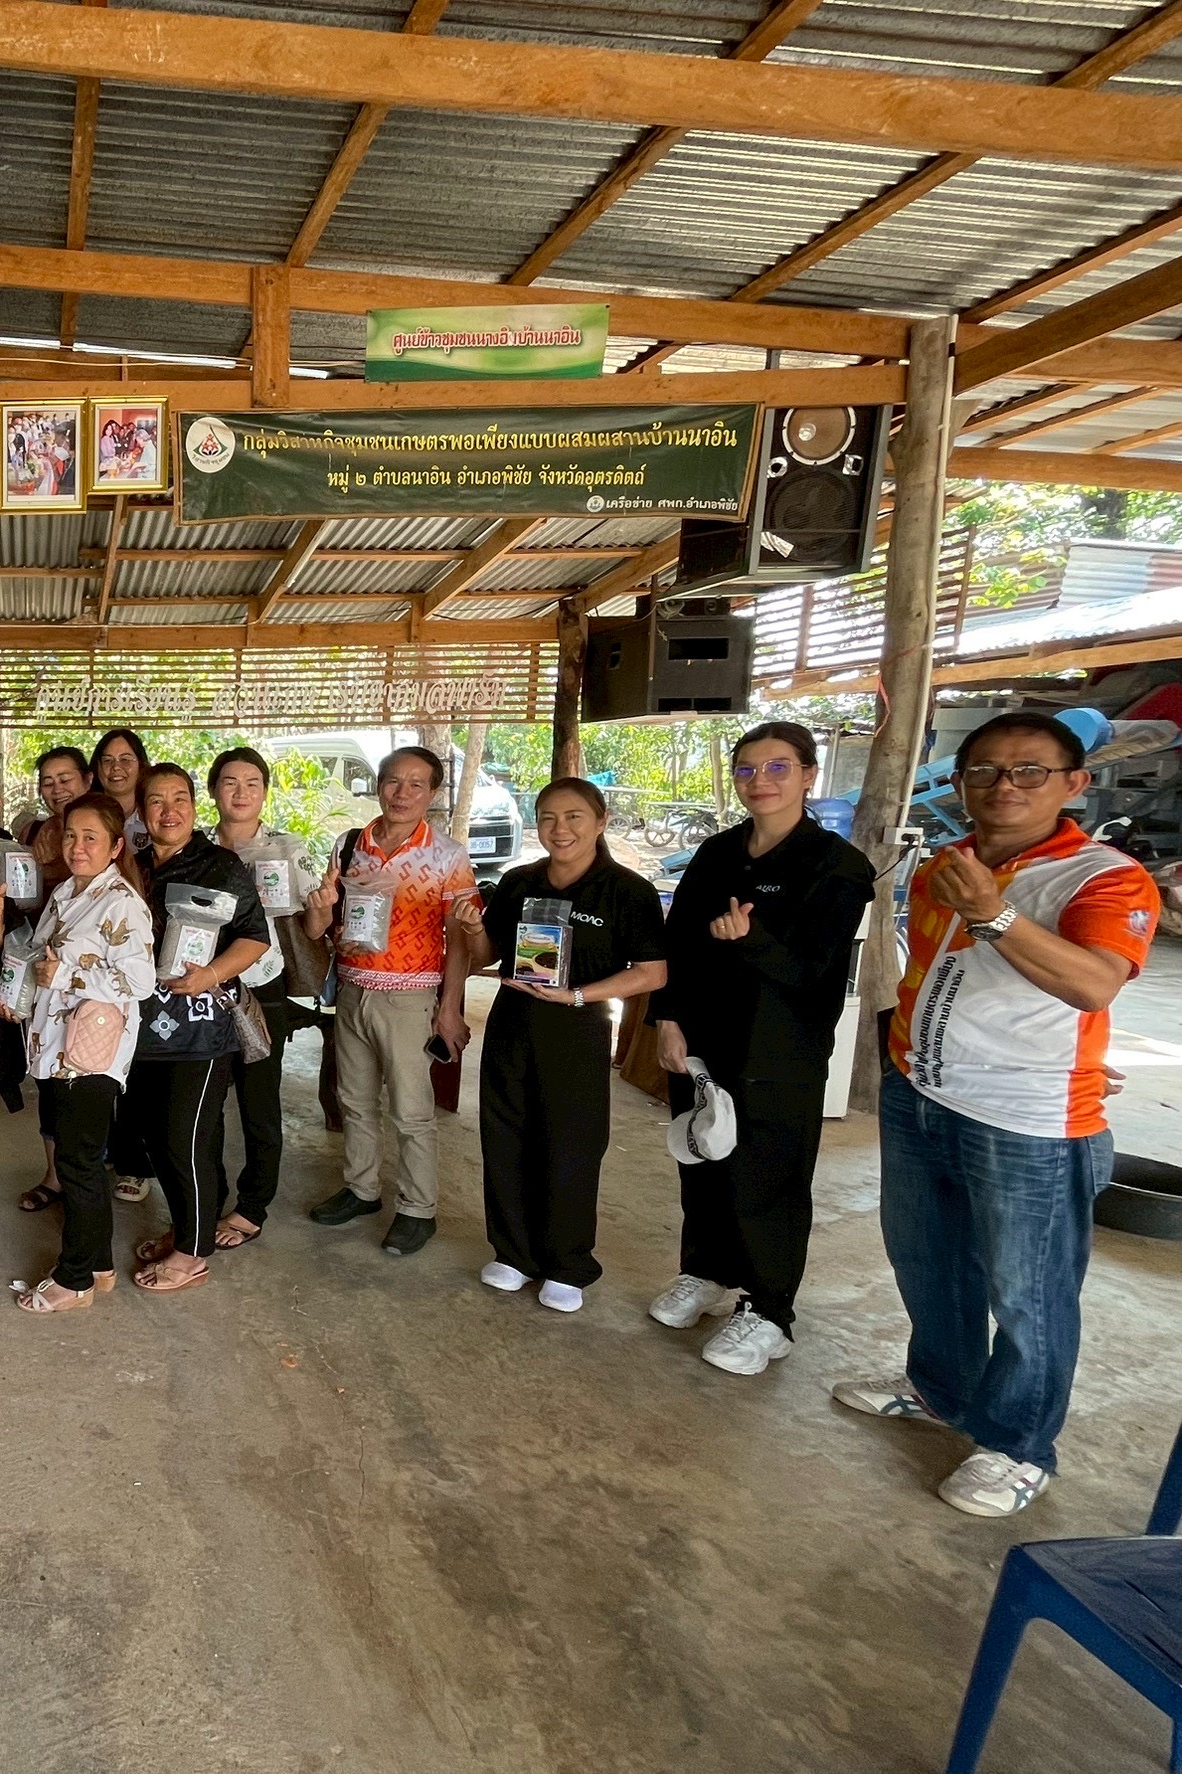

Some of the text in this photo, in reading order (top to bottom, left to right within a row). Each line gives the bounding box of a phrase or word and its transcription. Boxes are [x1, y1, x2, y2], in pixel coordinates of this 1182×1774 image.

[243, 421, 738, 459] กลุ่มวิสาหกิจชุมชนเกษตรพอเพียงแบบผสมผสานบ้านนาอิน
[327, 463, 647, 493] หมู่ ๒ ตำบลนาอิน อำเภอพิชัย จังหวัดอุตรดิตถ์
[606, 495, 653, 509] เครือข่าย
[571, 910, 604, 927] MOAC
